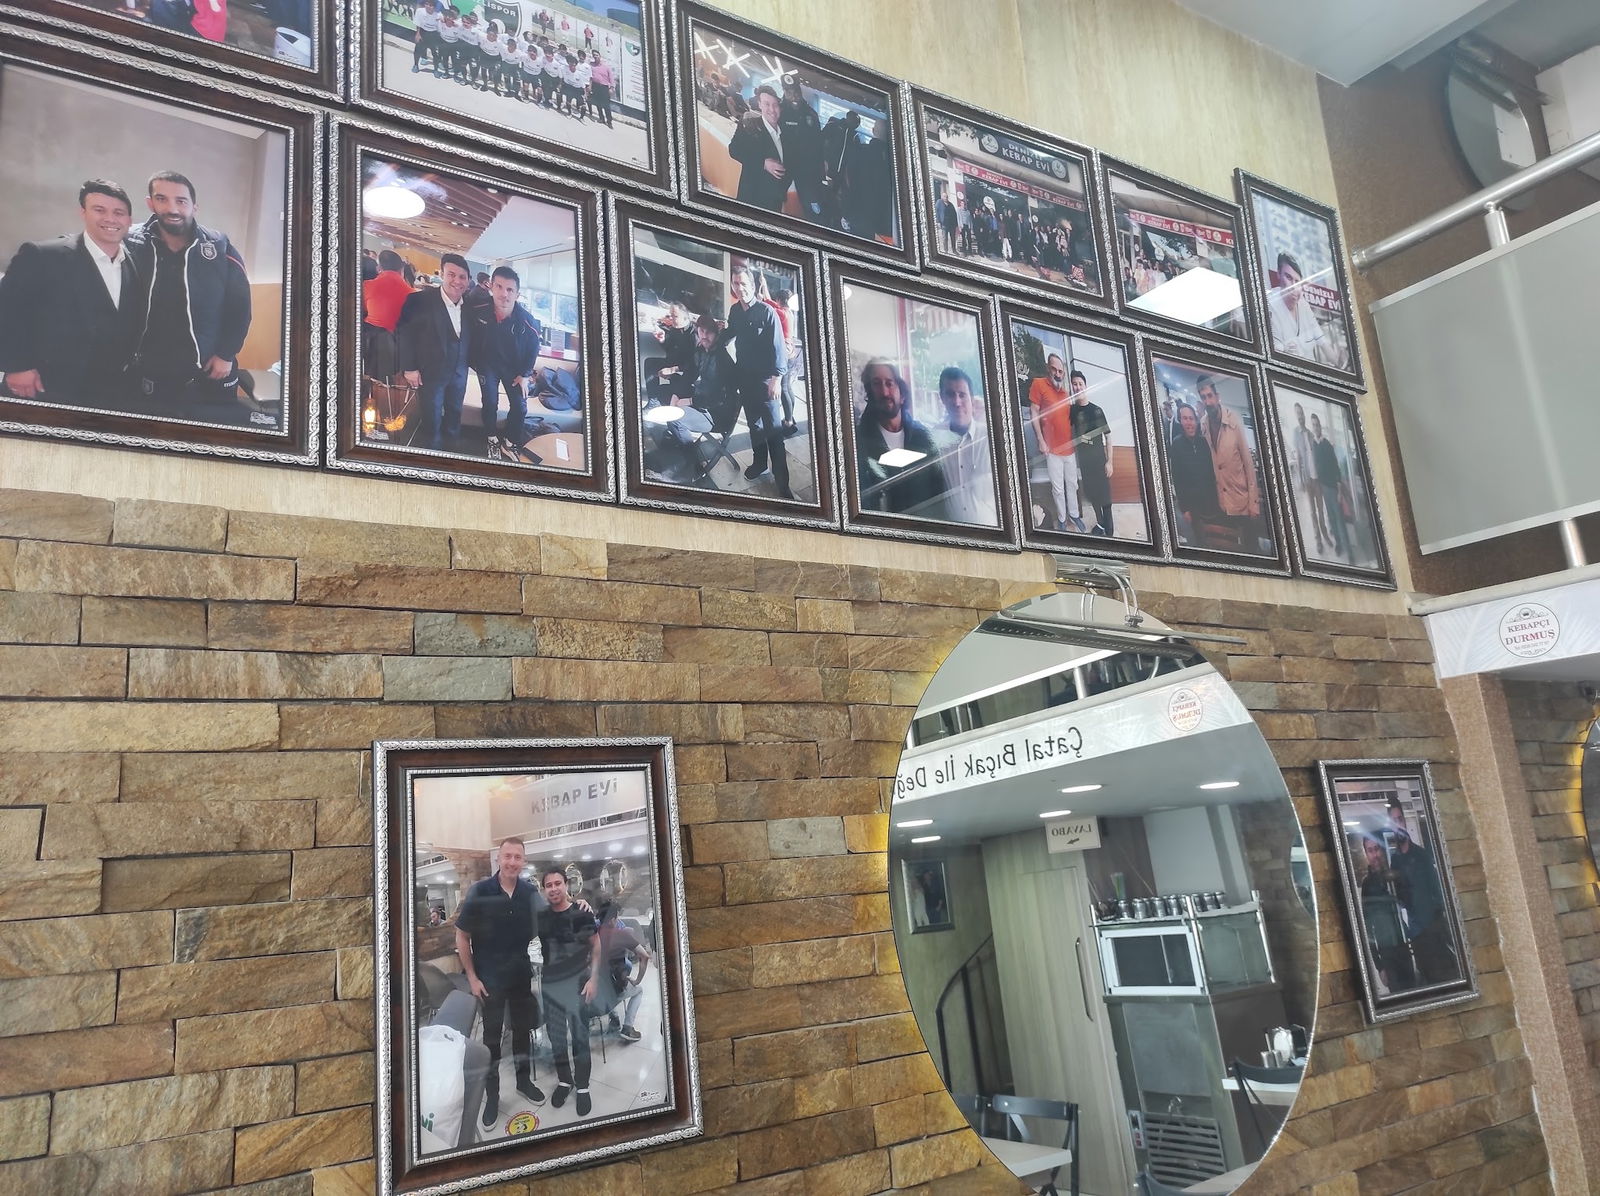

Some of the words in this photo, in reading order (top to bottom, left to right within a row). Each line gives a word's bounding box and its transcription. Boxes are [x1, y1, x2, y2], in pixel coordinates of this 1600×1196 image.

[1002, 147, 1033, 165] KEBAP
[1507, 619, 1550, 633] KEBAPÇI
[1505, 629, 1555, 645] DURMUŞ
[531, 788, 582, 815] KEBAP
